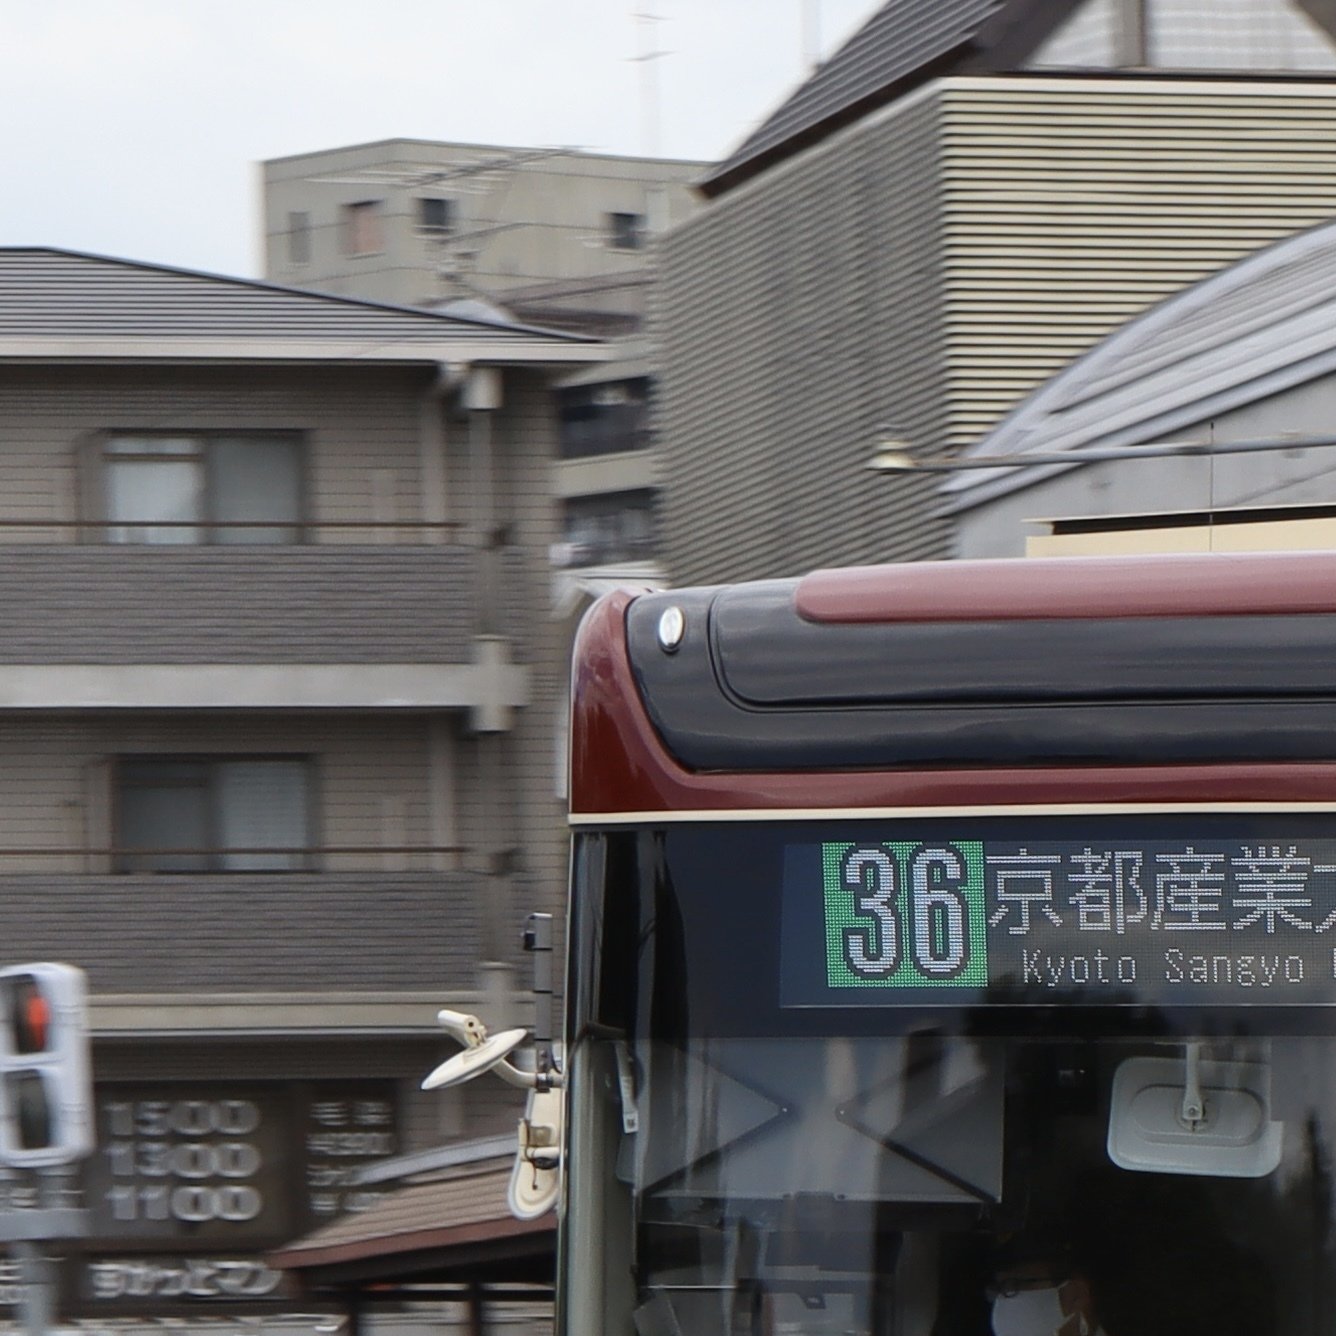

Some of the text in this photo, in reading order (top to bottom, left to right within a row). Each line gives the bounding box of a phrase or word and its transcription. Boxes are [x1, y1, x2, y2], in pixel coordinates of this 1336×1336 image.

[844, 845, 964, 976] 36
[1022, 947, 1138, 988] Kyoto
[1164, 947, 1306, 987] Sangyo
[104, 1185, 263, 1221] 1100
